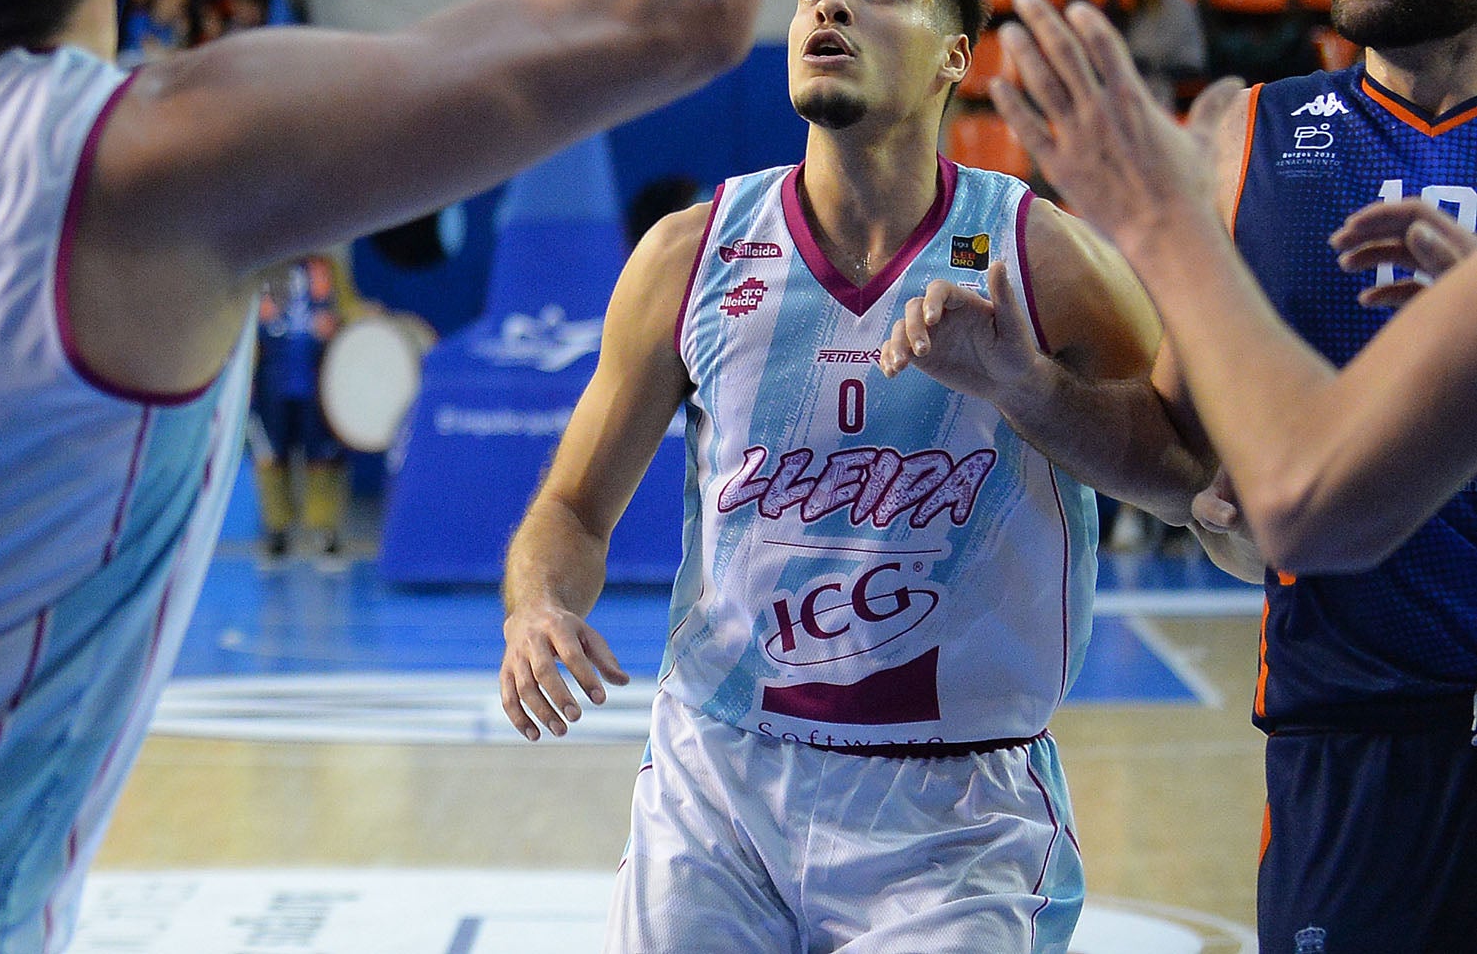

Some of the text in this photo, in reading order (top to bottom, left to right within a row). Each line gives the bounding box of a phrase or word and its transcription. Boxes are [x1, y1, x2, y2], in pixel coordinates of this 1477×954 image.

[817, 350, 872, 363] PENTEX
[838, 379, 865, 434] 0
[717, 446, 997, 528] LLEIDA
[773, 562, 911, 653] ICG
